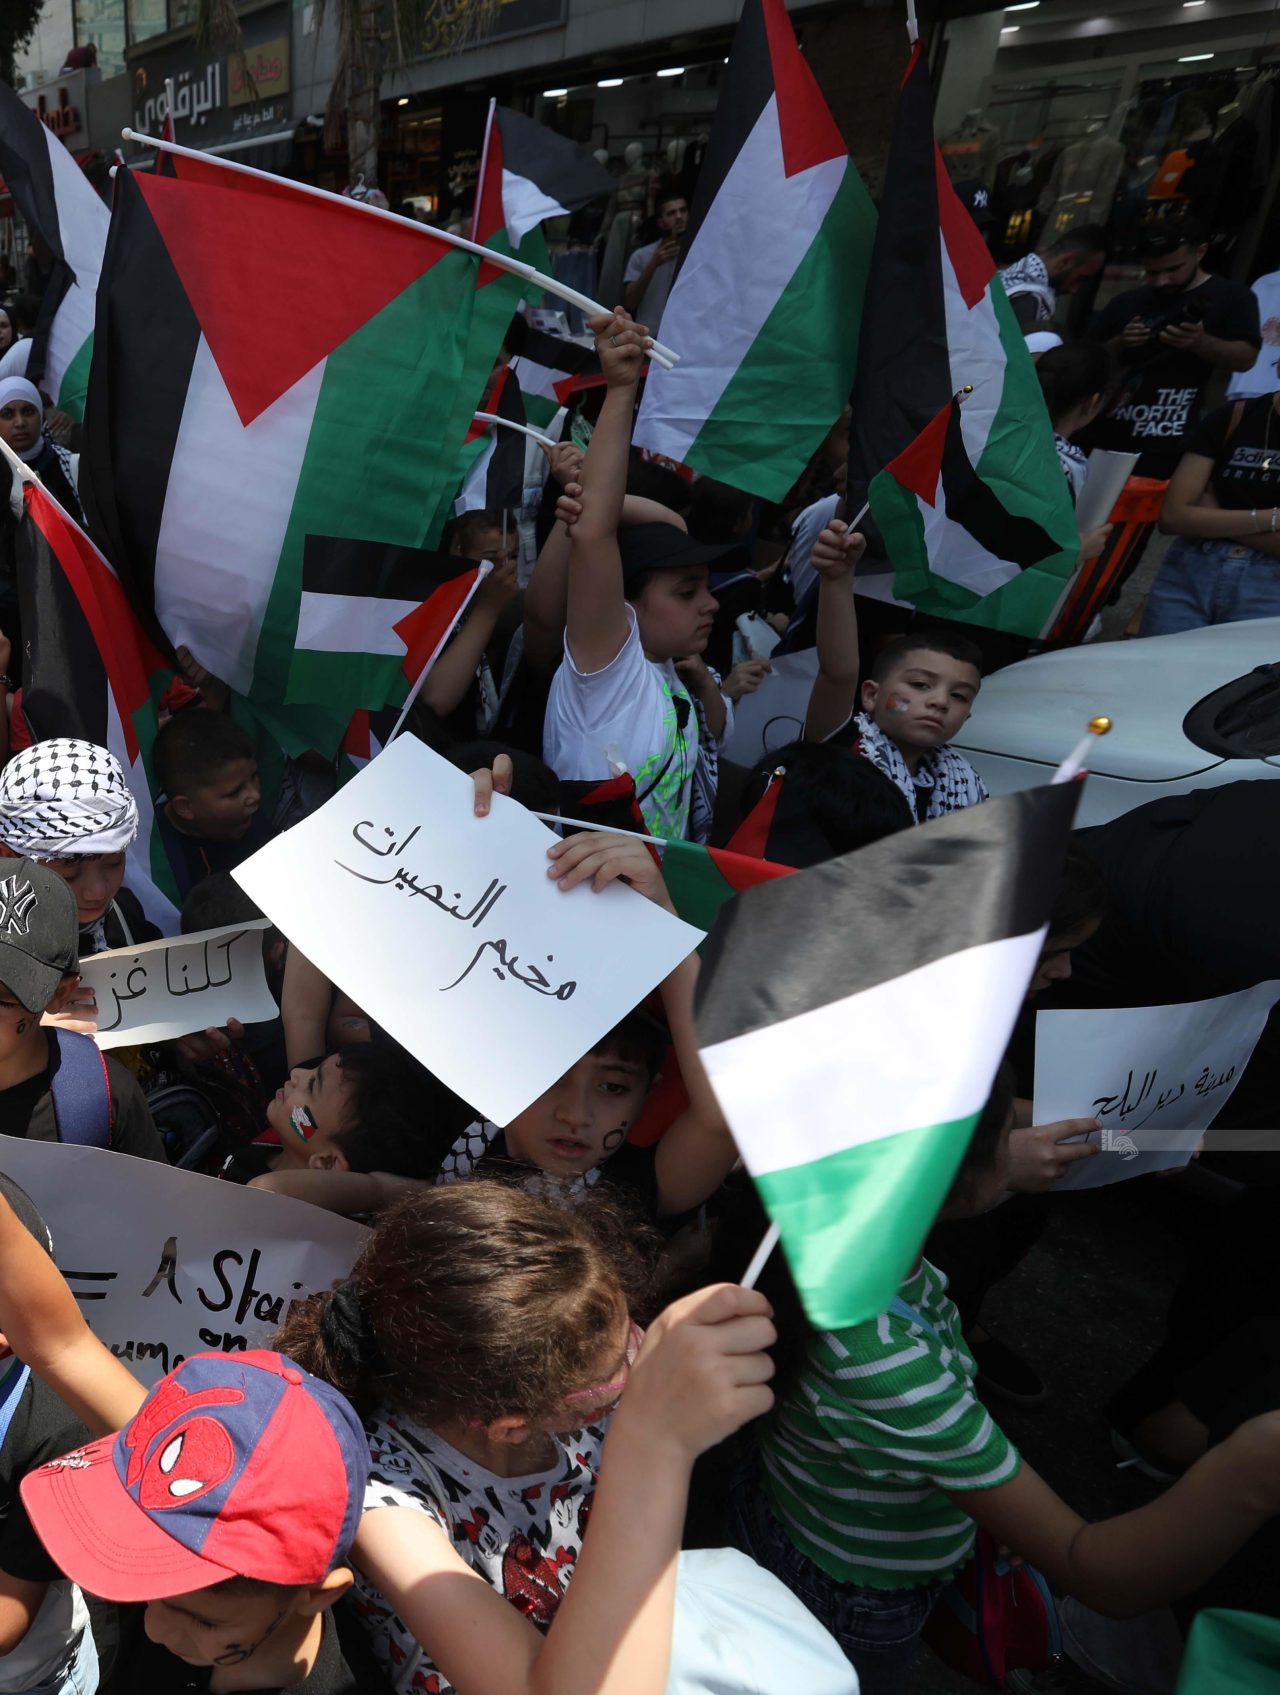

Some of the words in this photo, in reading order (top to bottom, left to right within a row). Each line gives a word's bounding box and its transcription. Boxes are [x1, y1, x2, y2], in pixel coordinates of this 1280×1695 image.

[1114, 405, 1191, 422] NORTH
[1157, 388, 1198, 406] THE
[1132, 421, 1187, 437] FACE
[333, 820, 508, 928] النصيرات
[167, 929, 250, 997] كلنا
[439, 938, 577, 1001] مخيم
[87, 957, 148, 1033] غز
[1124, 1083, 1185, 1136] دير
[141, 1236, 183, 1305] A
